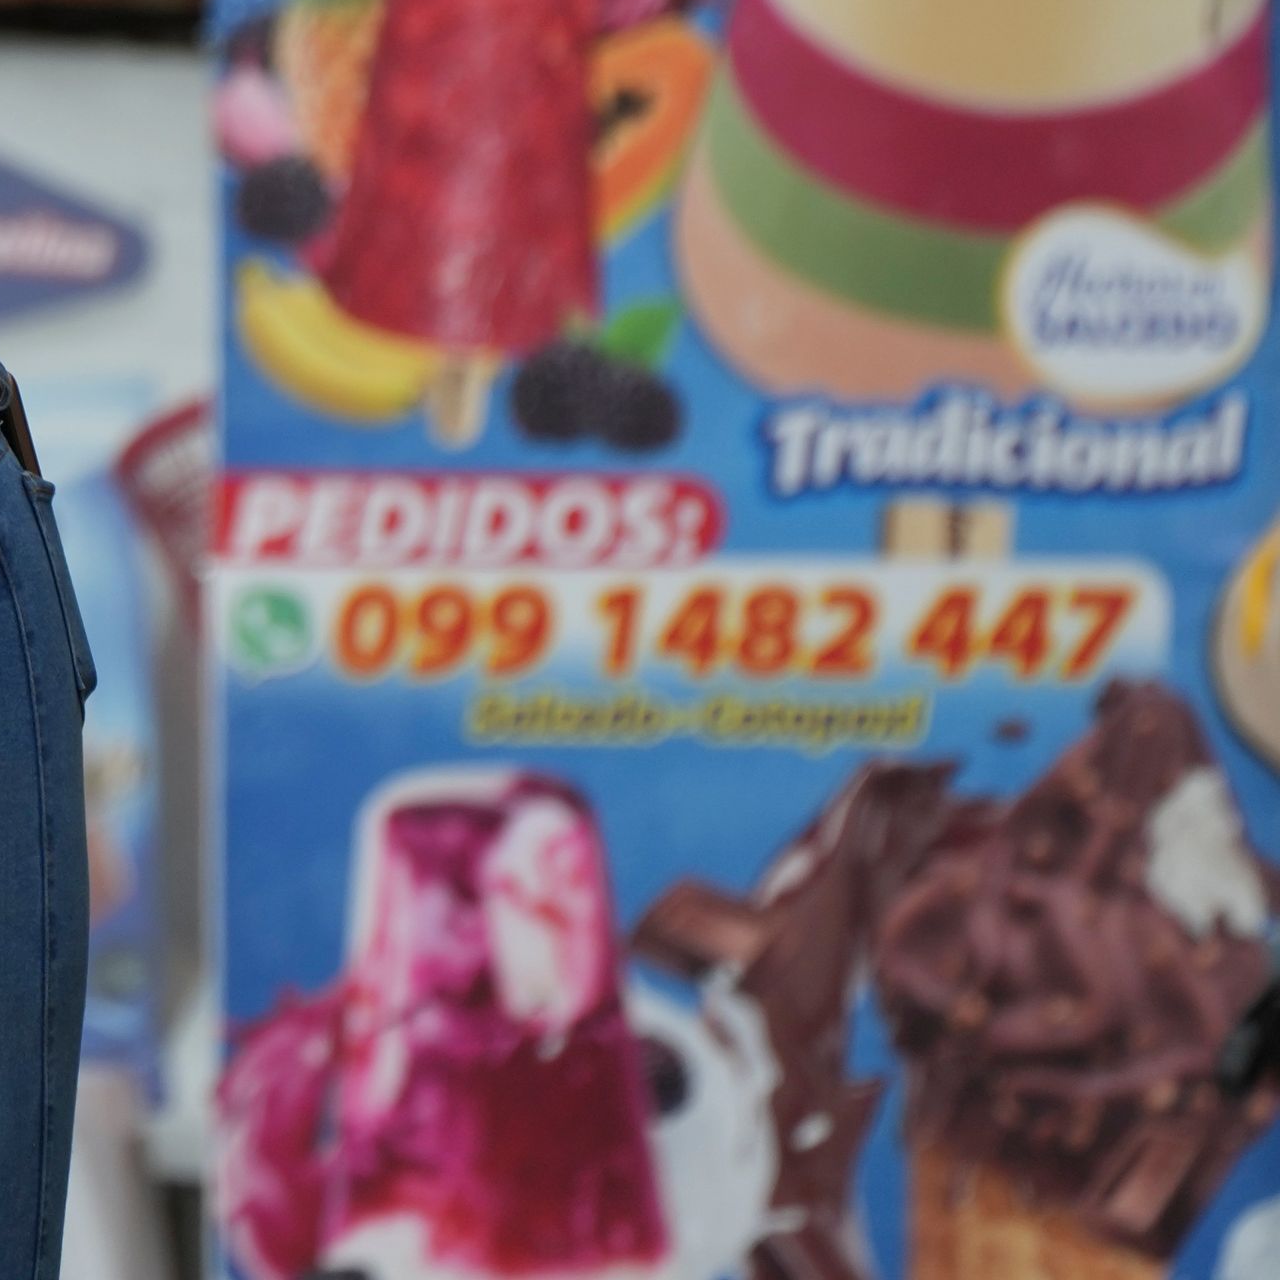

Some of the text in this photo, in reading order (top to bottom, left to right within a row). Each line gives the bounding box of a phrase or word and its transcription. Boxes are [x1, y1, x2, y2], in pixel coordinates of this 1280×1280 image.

[768, 388, 1248, 496] Tradicional
[238, 472, 708, 566] PEDIDOS:
[335, 580, 1138, 680] 099 1482 447
